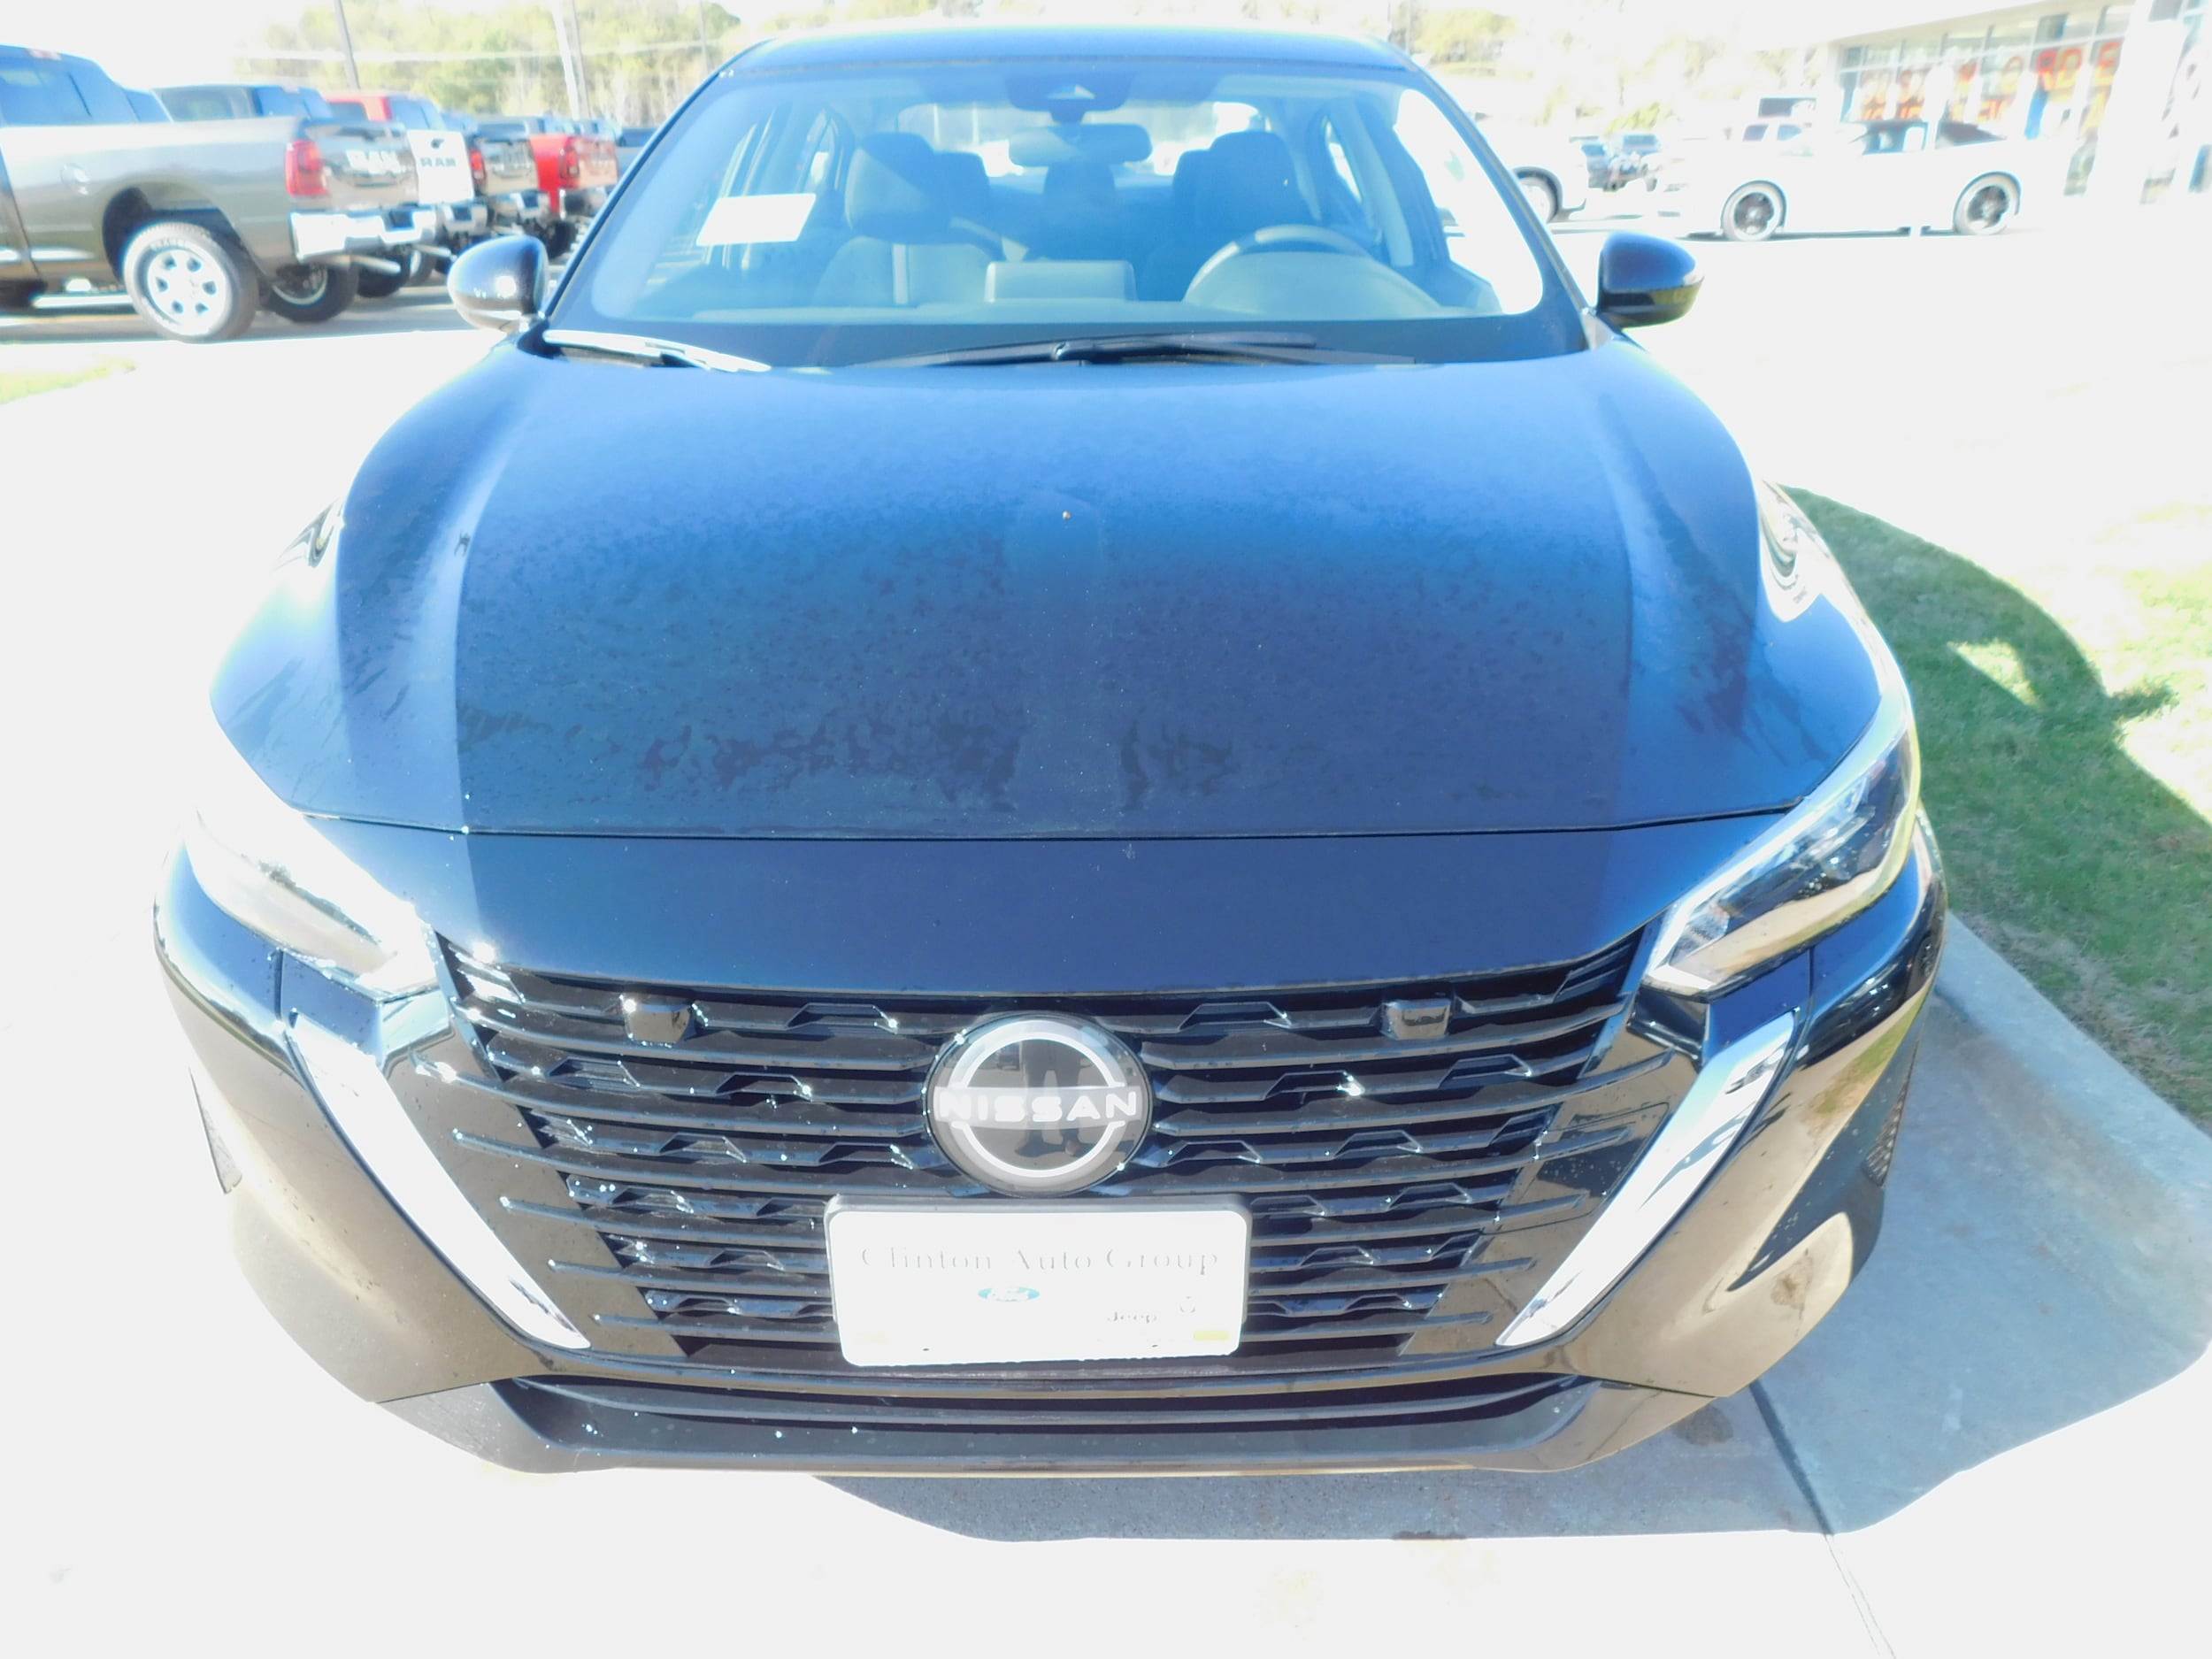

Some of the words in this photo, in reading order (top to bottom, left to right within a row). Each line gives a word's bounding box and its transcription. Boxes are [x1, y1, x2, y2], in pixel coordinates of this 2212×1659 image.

[419, 157, 457, 168] RAM
[939, 1091, 1137, 1123] NISSAN
[862, 1247, 992, 1270] Clinton
[1016, 1249, 1092, 1271] Auto
[1106, 1248, 1217, 1276] Group
